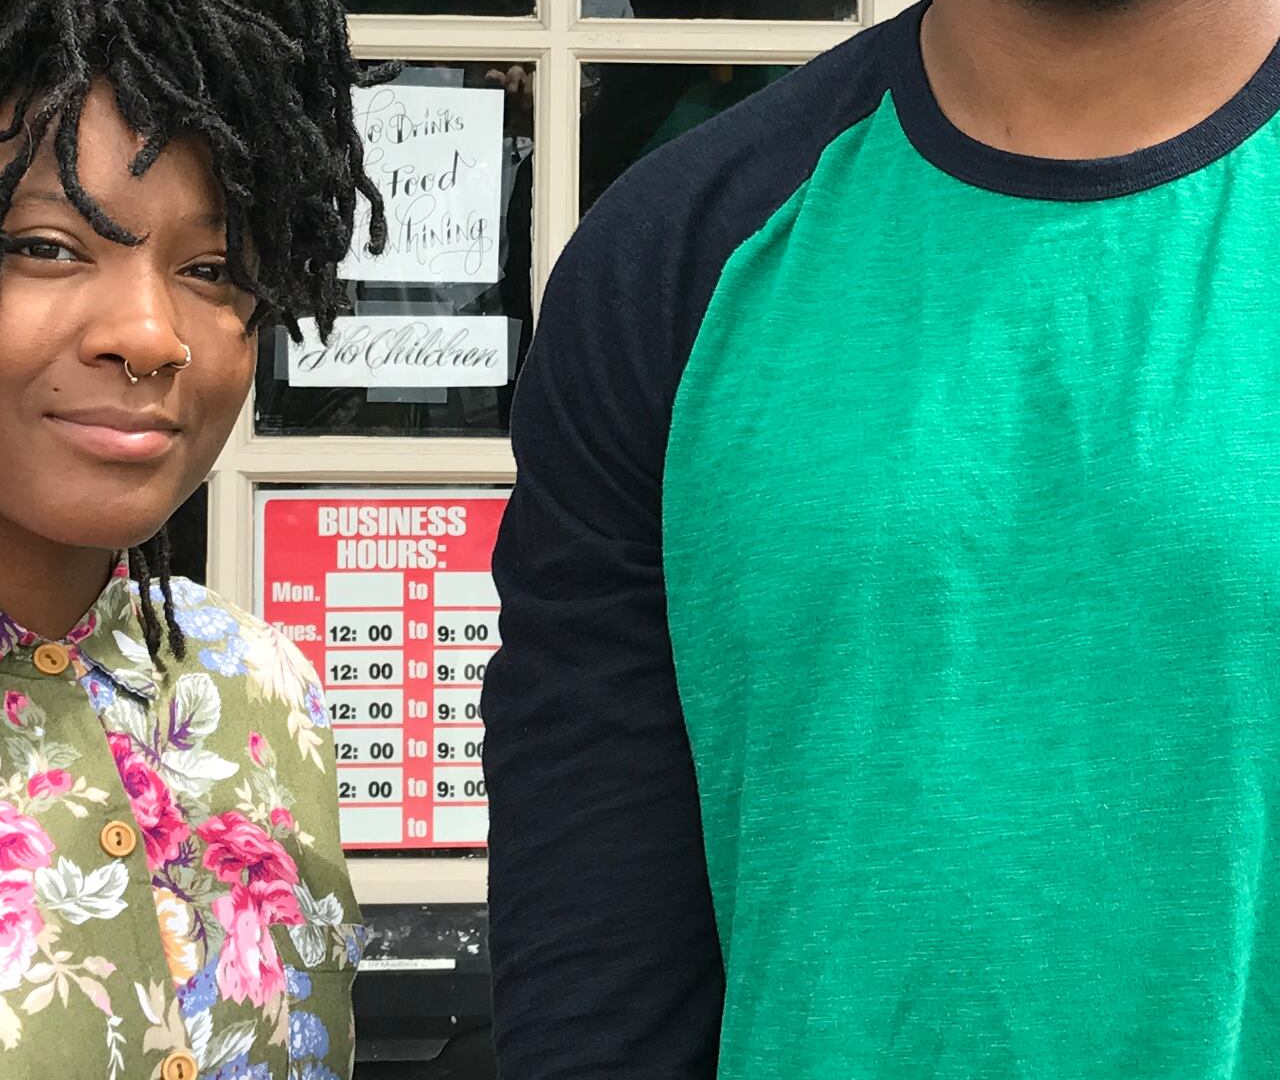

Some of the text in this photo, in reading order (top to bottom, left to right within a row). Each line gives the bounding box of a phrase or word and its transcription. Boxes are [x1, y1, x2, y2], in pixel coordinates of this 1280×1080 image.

[381, 149, 477, 199] Food
[298, 322, 500, 377] No Children
[318, 506, 466, 536] BUSINESS
[337, 539, 447, 569] HOURS:
[272, 581, 428, 602] Mon. to
[329, 625, 357, 642] 12:
[368, 624, 392, 641] 00
[408, 620, 428, 639] to
[437, 625, 455, 642] 9:
[464, 624, 488, 641] 00
[331, 664, 358, 681] 12:
[369, 662, 393, 679] 00
[408, 659, 428, 679] to
[437, 664, 455, 681] 9:
[329, 703, 356, 720] 12:
[369, 702, 393, 719] 00
[408, 698, 428, 718] to
[438, 703, 456, 720] 9:
[370, 742, 394, 759] 00
[408, 738, 428, 758] to
[437, 742, 455, 759] 9:
[339, 777, 487, 798] 2: 00 to 9: 00
[408, 817, 428, 838] to
